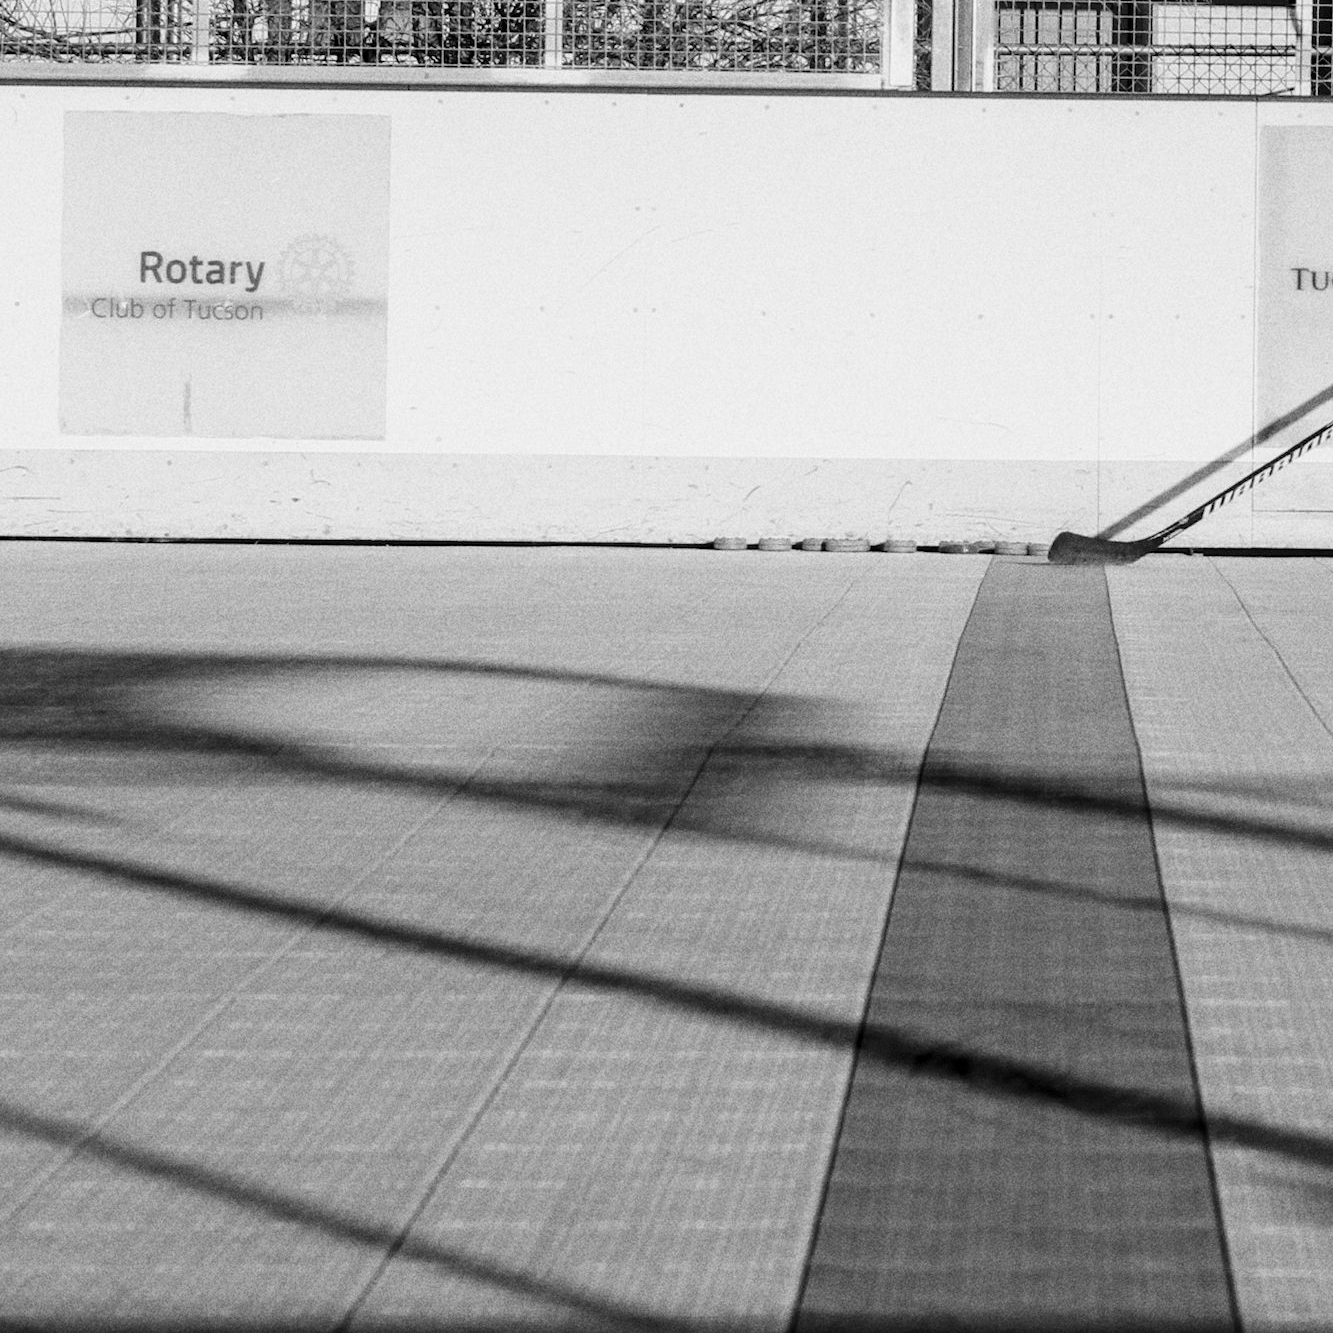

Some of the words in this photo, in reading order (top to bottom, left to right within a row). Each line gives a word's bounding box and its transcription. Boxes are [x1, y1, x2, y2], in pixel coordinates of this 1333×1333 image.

[139, 250, 266, 293] Rotary
[91, 297, 145, 319] Club
[152, 297, 177, 319] of
[182, 299, 264, 321] Tucson
